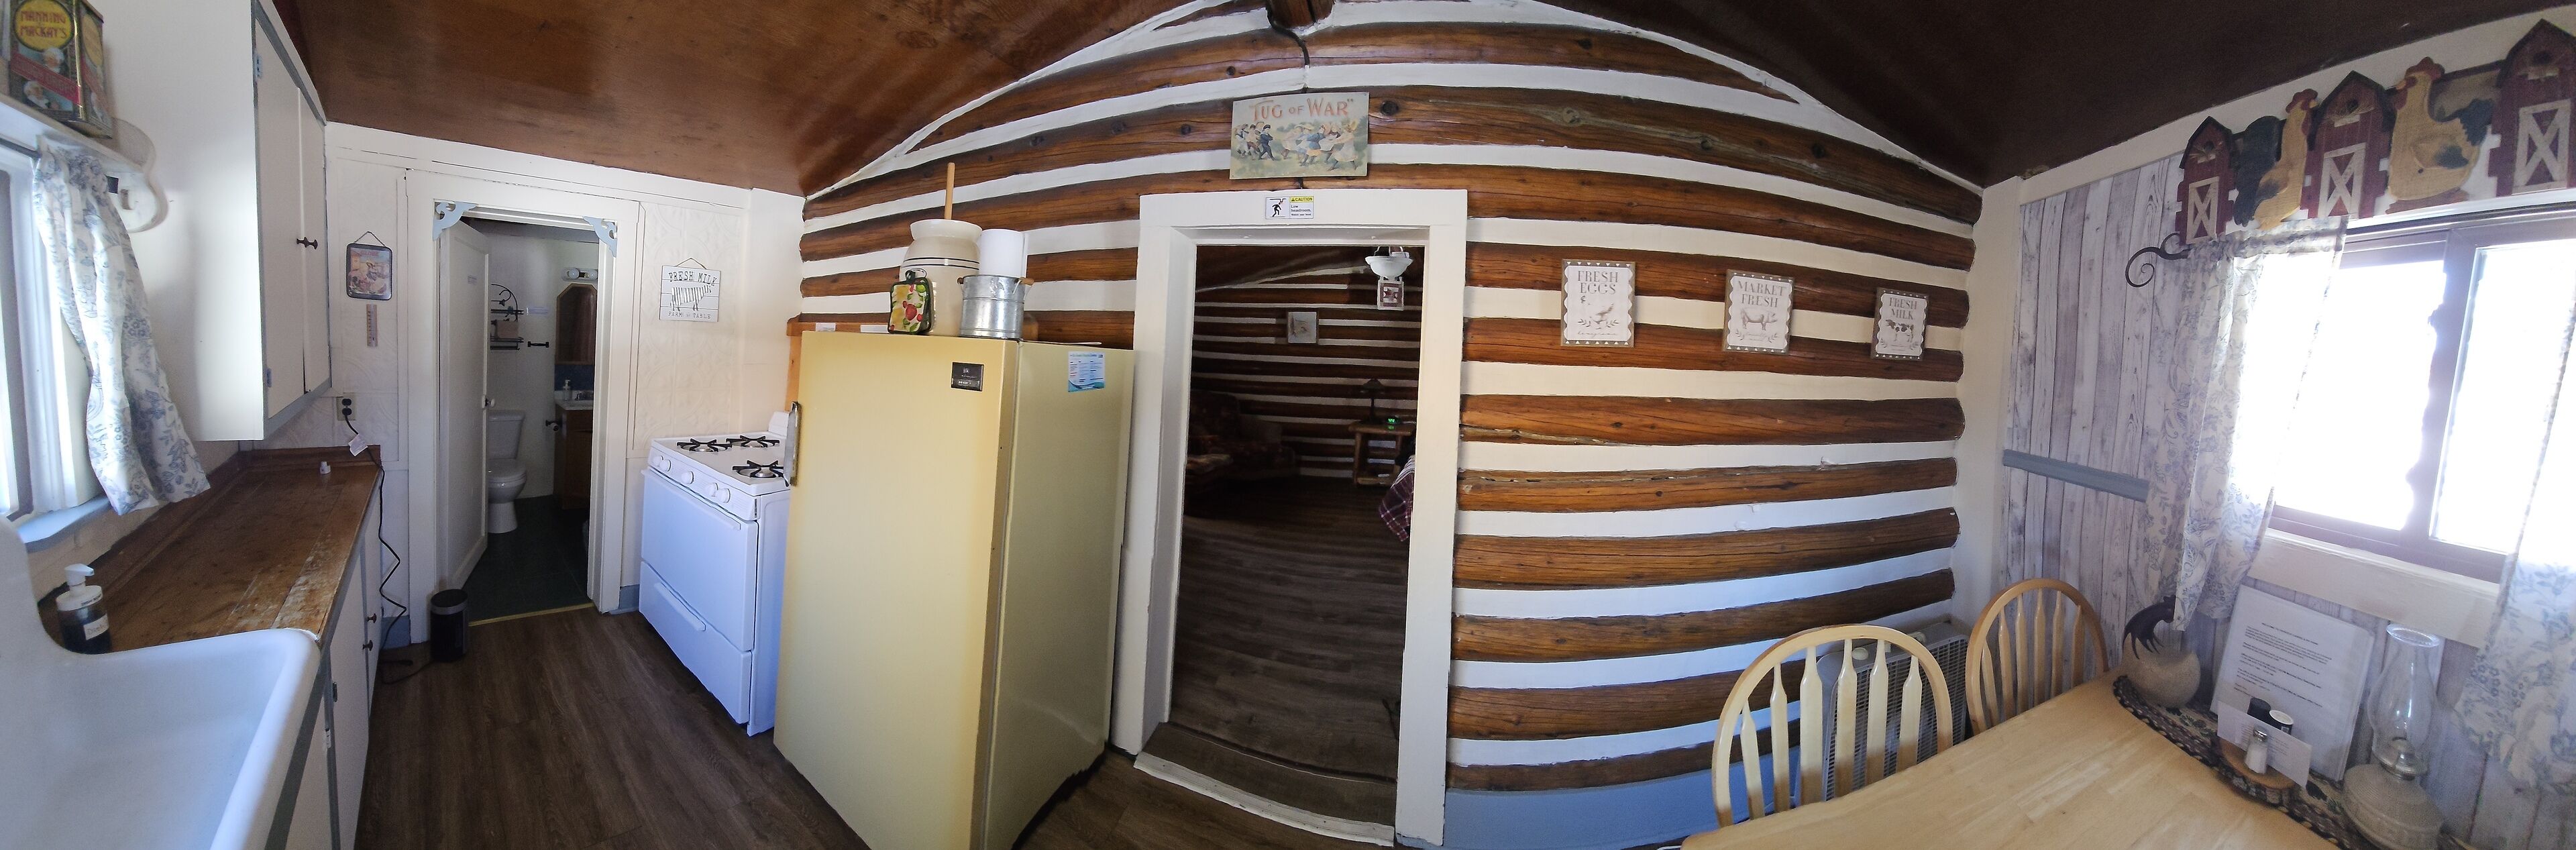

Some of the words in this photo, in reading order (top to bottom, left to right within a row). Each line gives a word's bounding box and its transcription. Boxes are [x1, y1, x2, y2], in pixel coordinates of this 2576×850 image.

[20, 10, 66, 24] MANNING
[19, 25, 68, 39] MACKAY'S
[1249, 100, 1283, 121] TUG
[1289, 105, 1304, 115] OF
[669, 271, 694, 282] FRESH
[698, 272, 717, 286] MILK
[1578, 270, 1619, 283] FRESH
[1580, 282, 1616, 295] EGGS
[1738, 280, 1786, 296] MARKET
[1741, 293, 1778, 308] FRESH
[1889, 297, 1917, 310] FRESH
[1891, 309, 1915, 320] MILK
